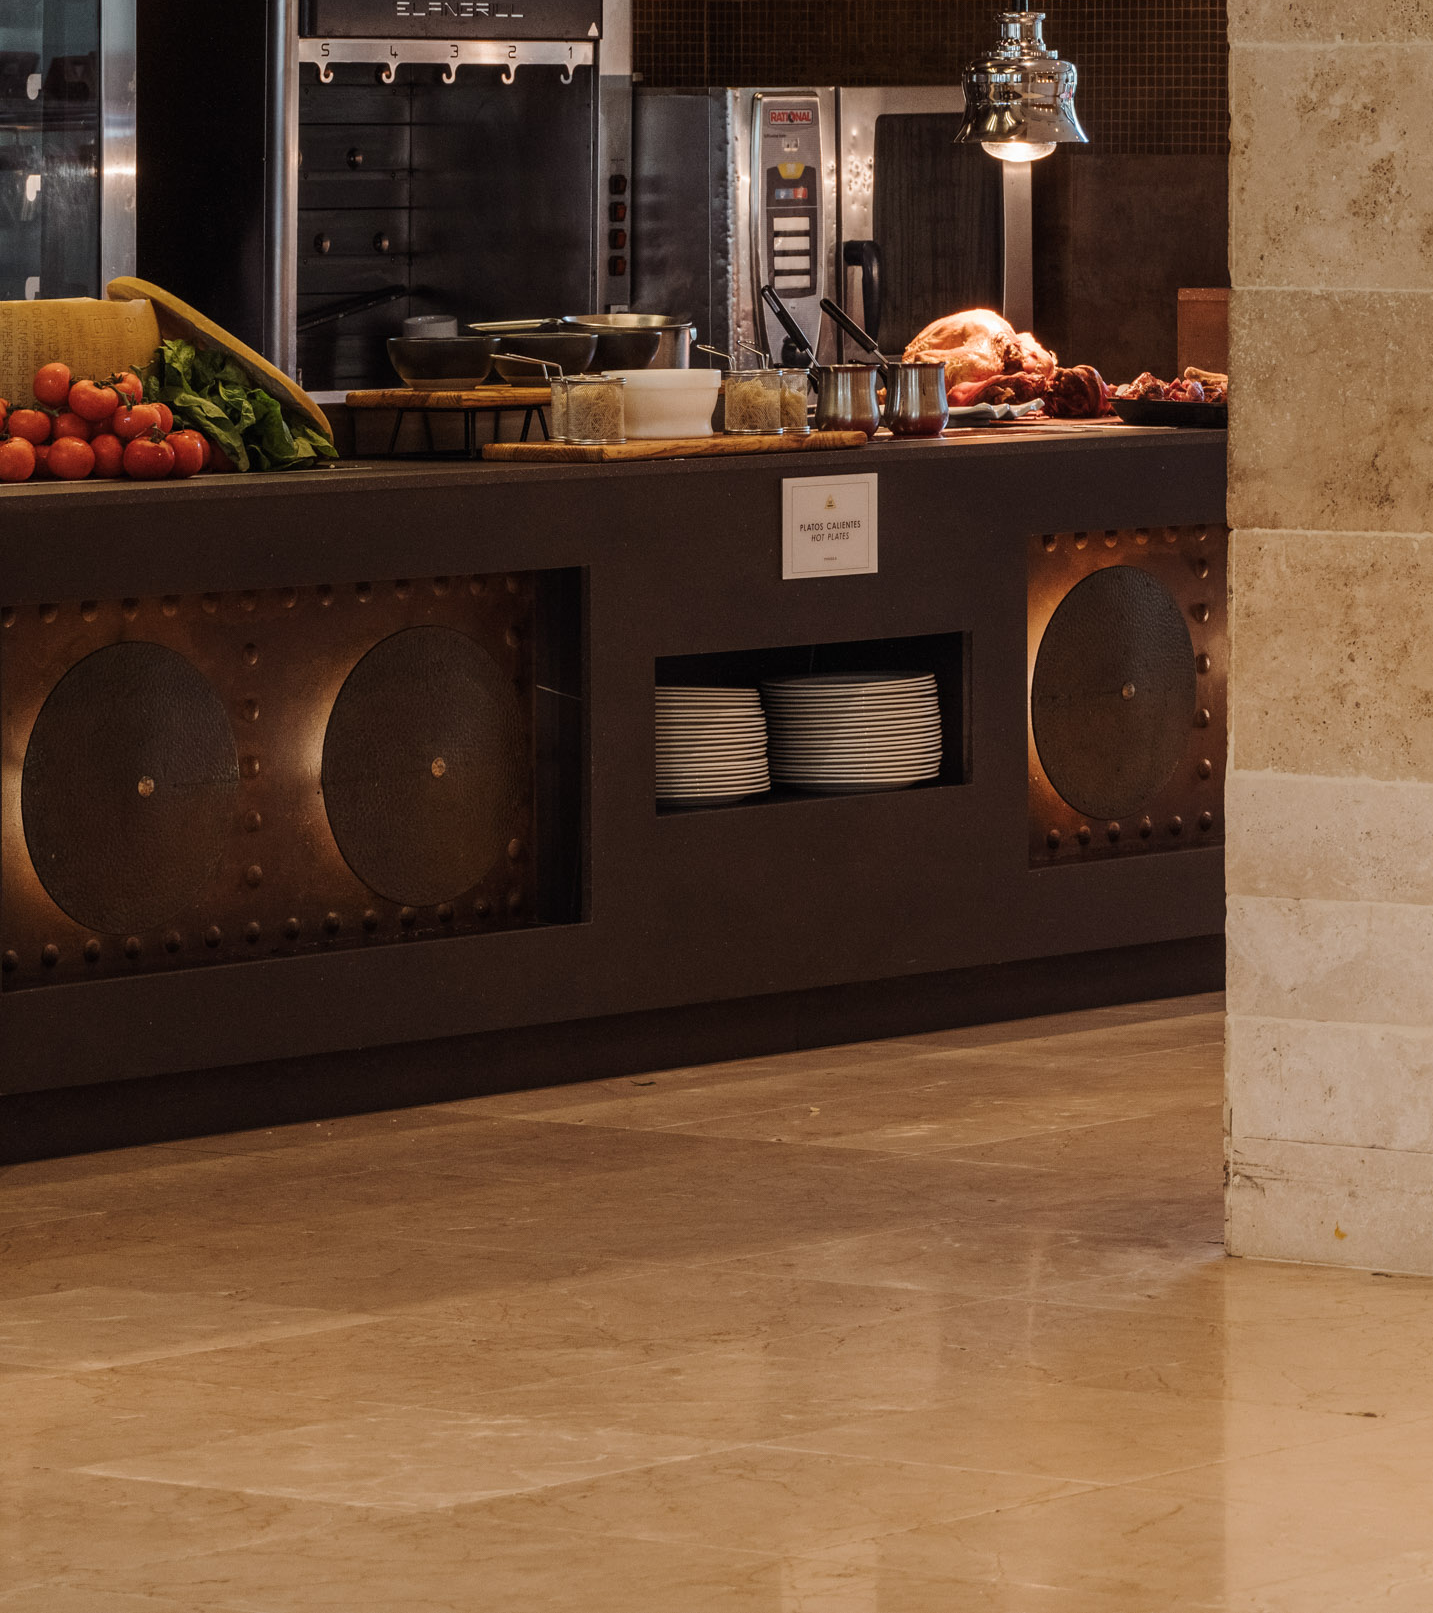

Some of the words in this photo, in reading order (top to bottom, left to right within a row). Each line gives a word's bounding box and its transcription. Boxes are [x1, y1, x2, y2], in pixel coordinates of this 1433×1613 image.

[320, 43, 329, 58] 5
[390, 46, 398, 58] 4
[450, 45, 459, 58] 3
[508, 46, 516, 58] 2
[568, 47, 572, 59] 1
[770, 112, 811, 123] RATIONAL
[800, 522, 824, 532] PLATOS
[826, 520, 861, 530] CALIENTES
[811, 534, 825, 542] HOT
[827, 532, 850, 541] PLATES
